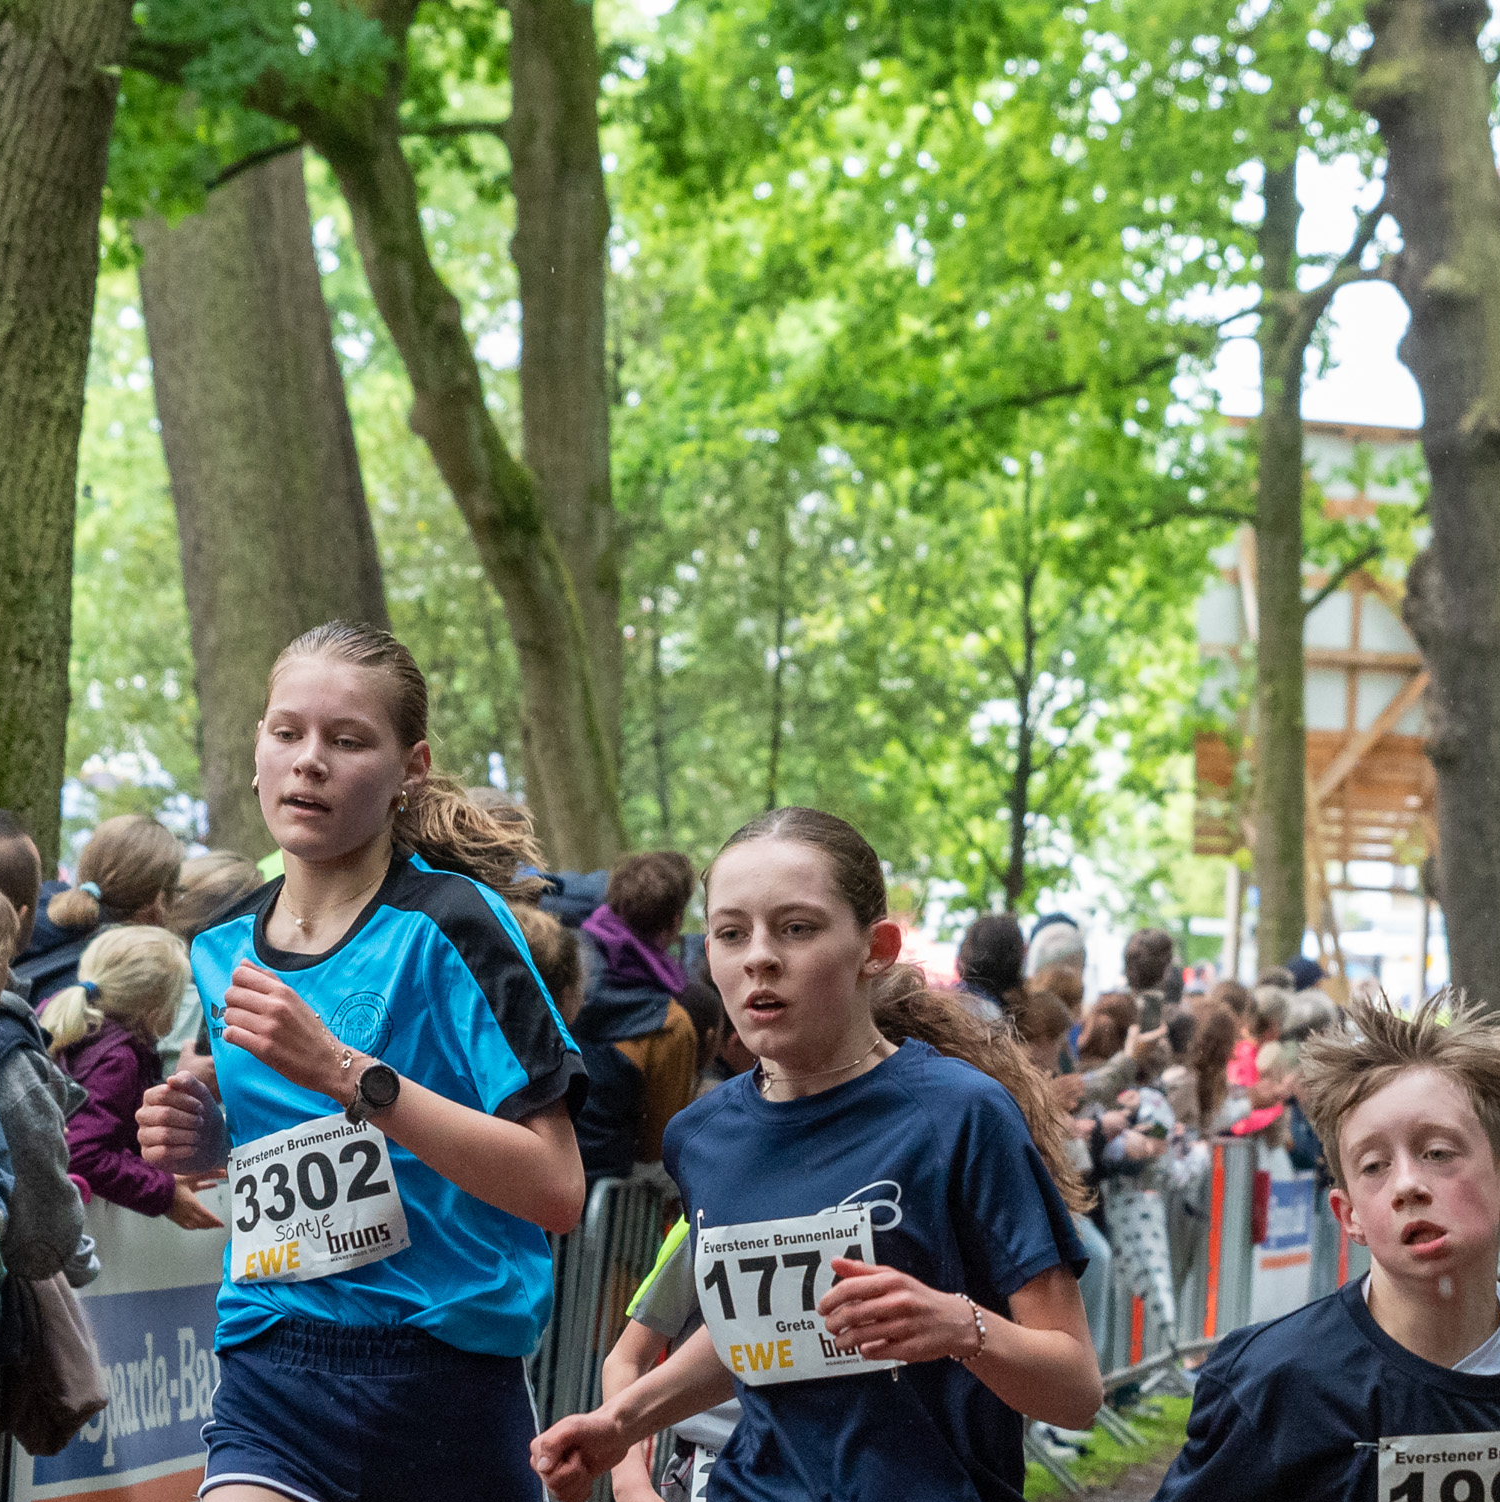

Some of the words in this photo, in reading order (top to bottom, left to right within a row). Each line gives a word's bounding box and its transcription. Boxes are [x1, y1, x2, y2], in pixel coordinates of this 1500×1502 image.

[236, 1145, 285, 1171] Everstener
[287, 1121, 368, 1151] Brunnenlauf
[235, 1140, 390, 1232] 3302
[275, 1214, 334, 1242] Söntje
[326, 1223, 391, 1254] bruns
[704, 1238, 769, 1254] Everstener
[774, 1225, 858, 1246] Brunnenlauf
[245, 1241, 300, 1279] EWE
[775, 1319, 815, 1332] Greta
[729, 1339, 794, 1372] EWE
[79, 1327, 221, 1467] parda-Ba
[1395, 1450, 1483, 1465] Everstener
